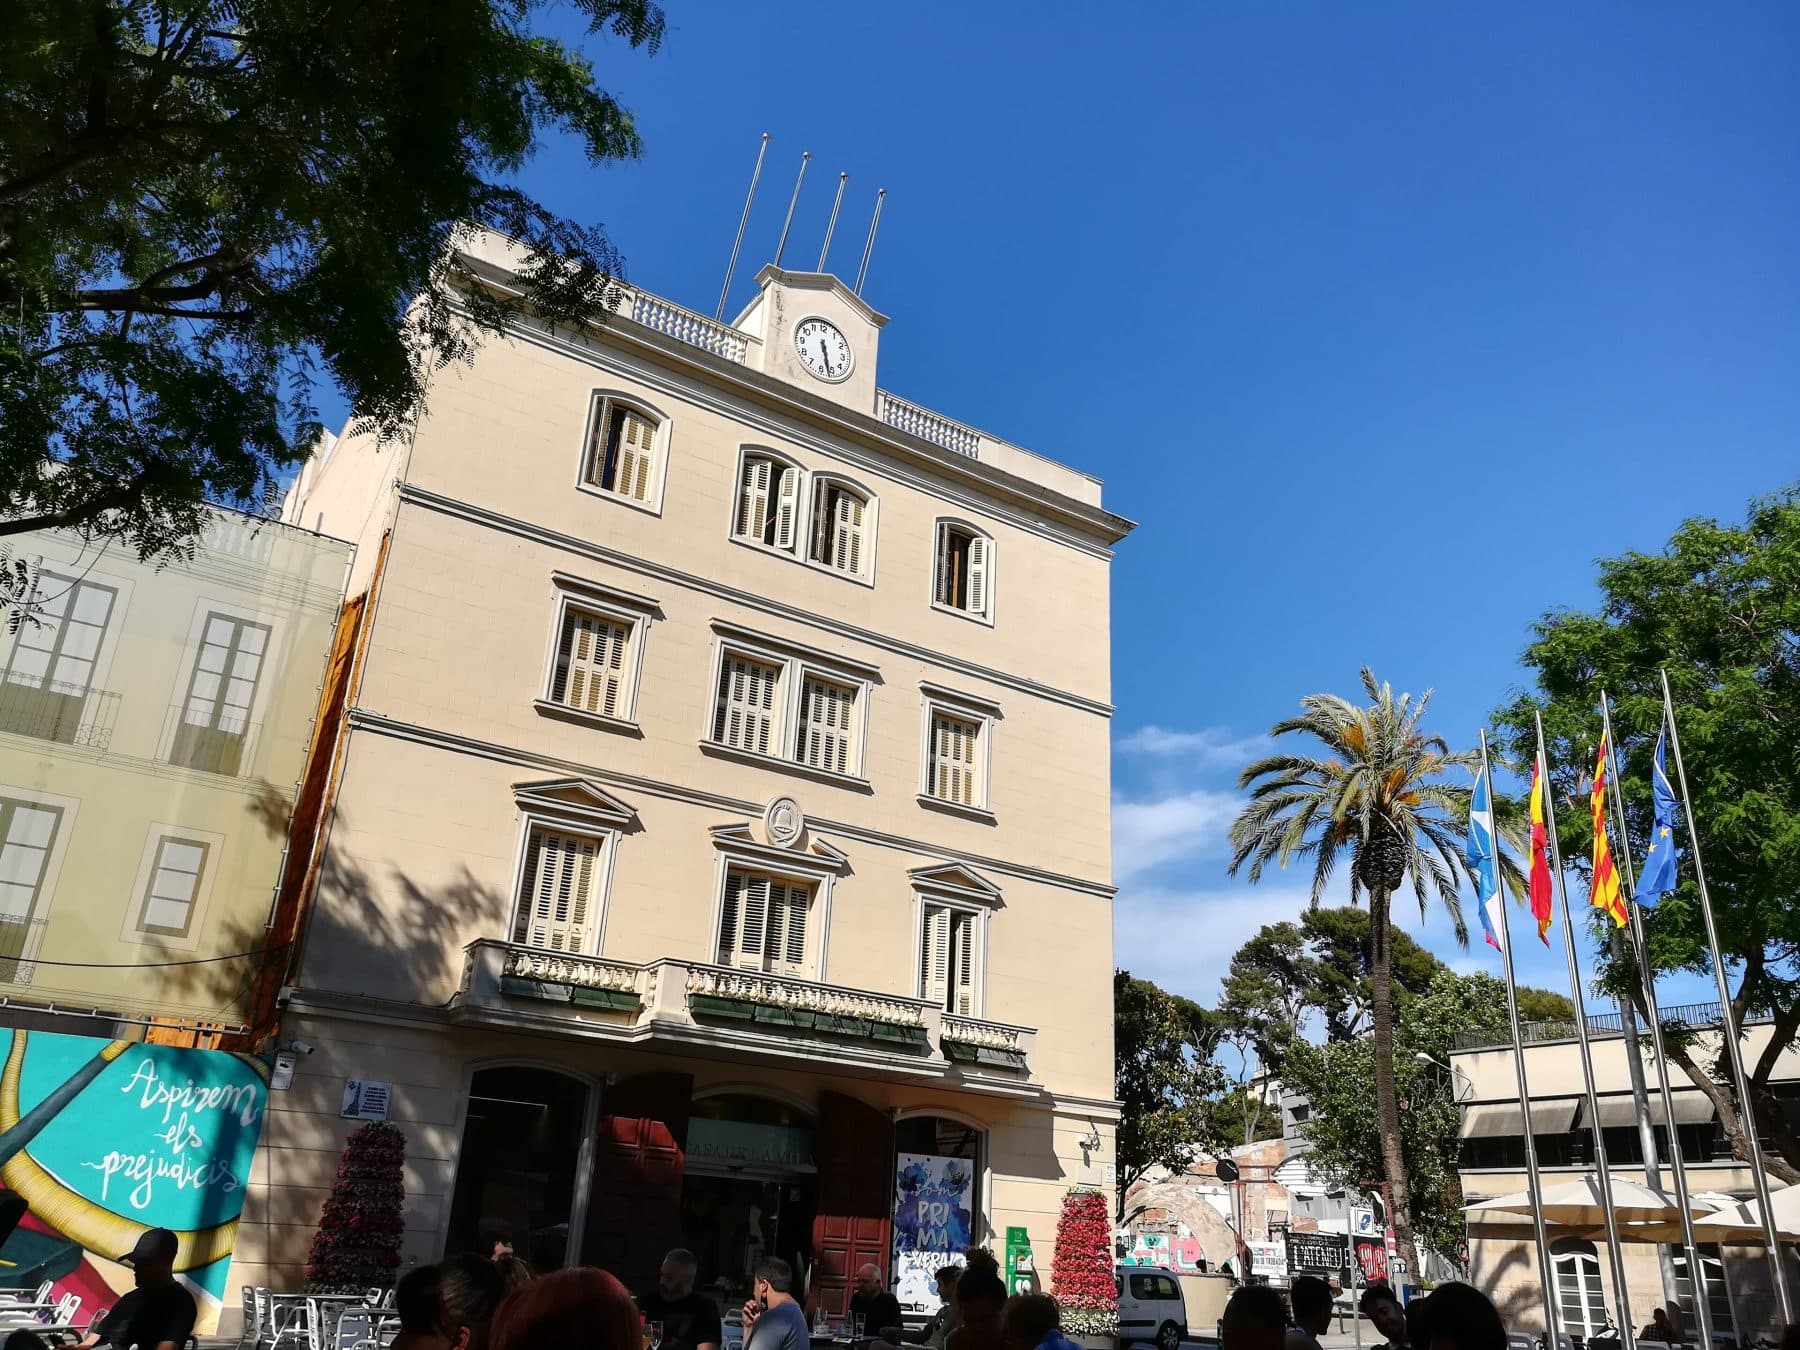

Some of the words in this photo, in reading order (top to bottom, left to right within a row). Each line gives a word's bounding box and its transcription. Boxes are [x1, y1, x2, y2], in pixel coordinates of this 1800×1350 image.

[803, 328, 811, 336] 10
[820, 324, 828, 333] 12
[801, 348, 807, 356] 8
[121, 1058, 260, 1127] Aspirem
[152, 1112, 203, 1154] els
[80, 1149, 241, 1209] prejudicis
[913, 1184, 960, 1197] som
[918, 1200, 950, 1228] PRI
[917, 1228, 949, 1249] MA
